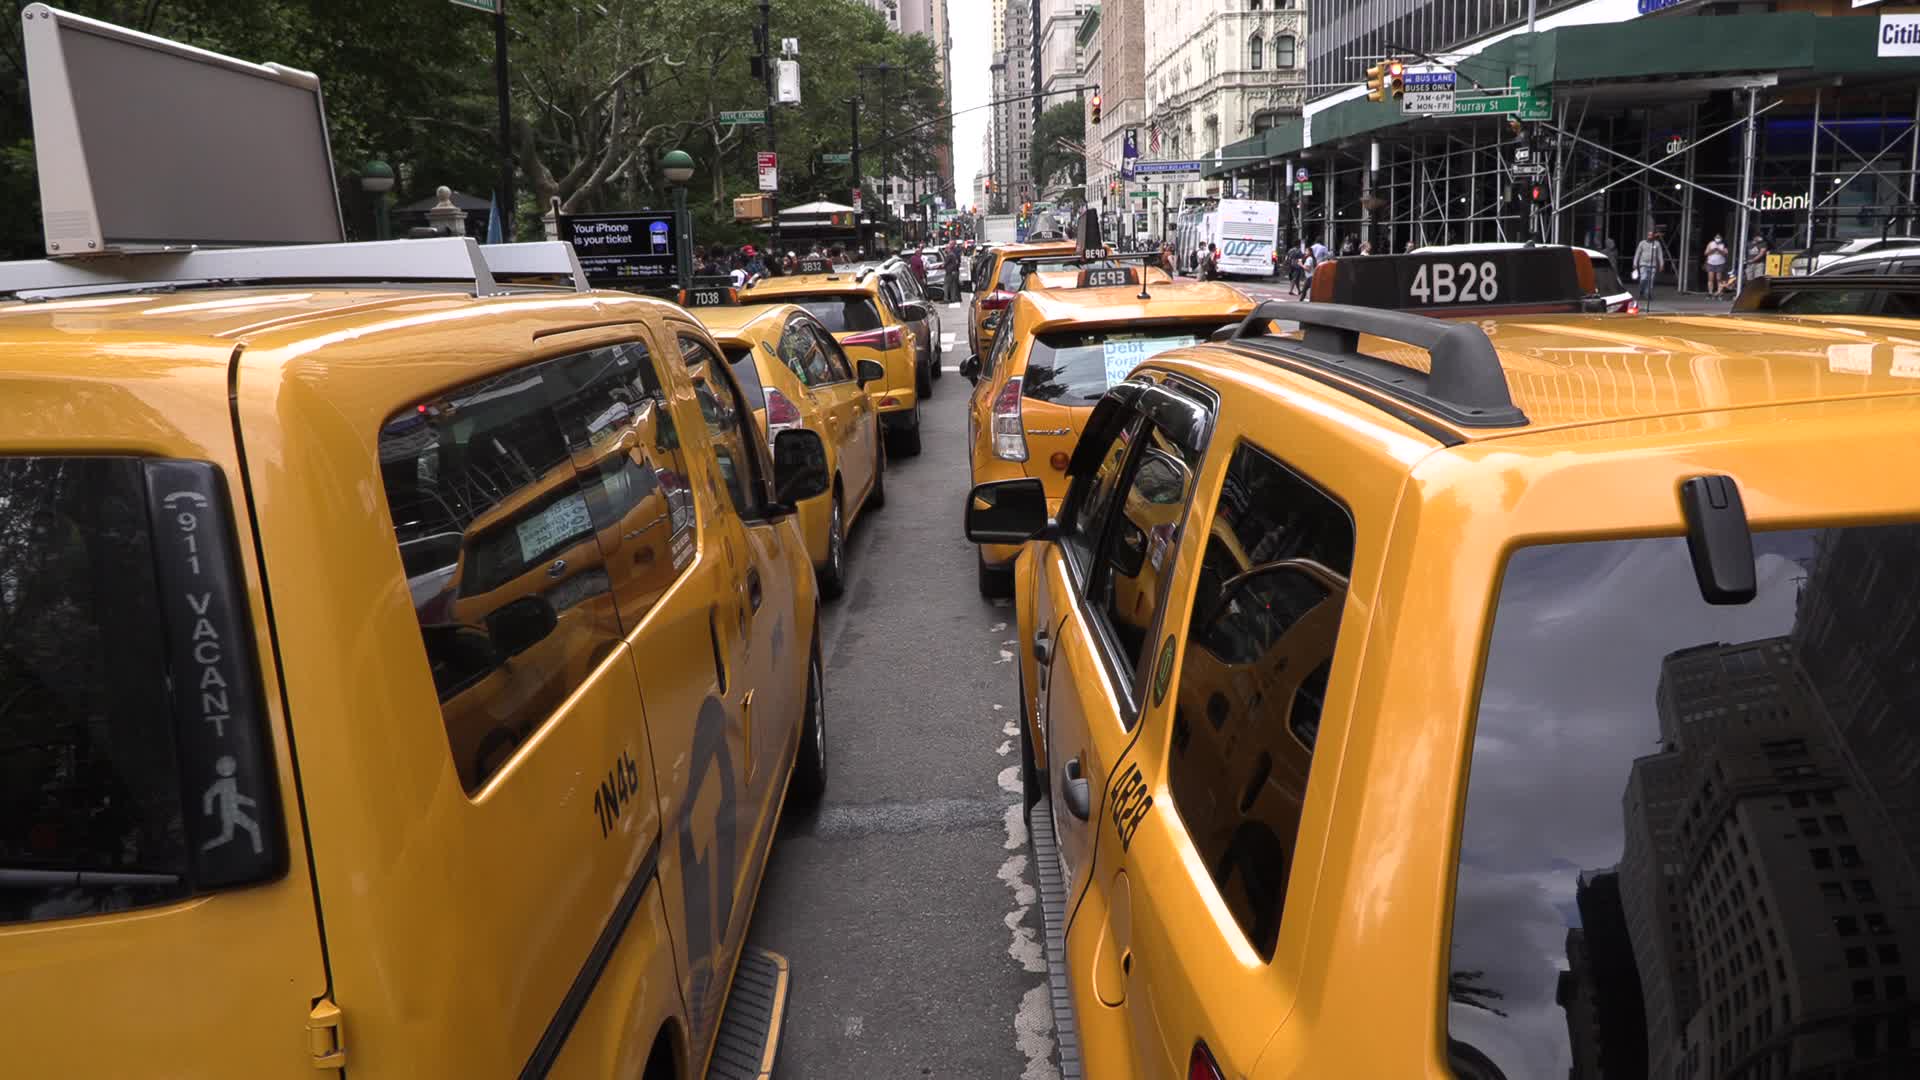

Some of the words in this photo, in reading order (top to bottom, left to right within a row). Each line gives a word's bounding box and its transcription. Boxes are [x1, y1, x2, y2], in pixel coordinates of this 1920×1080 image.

[1415, 74, 1430, 83] BUS
[1432, 73, 1453, 82] LANE
[1405, 83, 1430, 92] BUSES
[1432, 82, 1452, 91] ONLY
[1455, 102, 1486, 113] Murray
[1489, 101, 1498, 110] St
[573, 223, 594, 233] Your
[596, 223, 629, 233] iPhone
[573, 235, 583, 245] is
[583, 236, 604, 247] your
[606, 234, 632, 244] ticket
[1223, 240, 1264, 257] 007
[802, 261, 822, 272] 3B32
[1089, 271, 1125, 286] 6E93
[1410, 261, 1498, 303] 4B28
[695, 292, 720, 305] 7D38
[1105, 341, 1145, 355] Debt
[176, 512, 201, 575] 911
[186, 592, 231, 737] VACANT
[1110, 762, 1153, 854] 4B28
